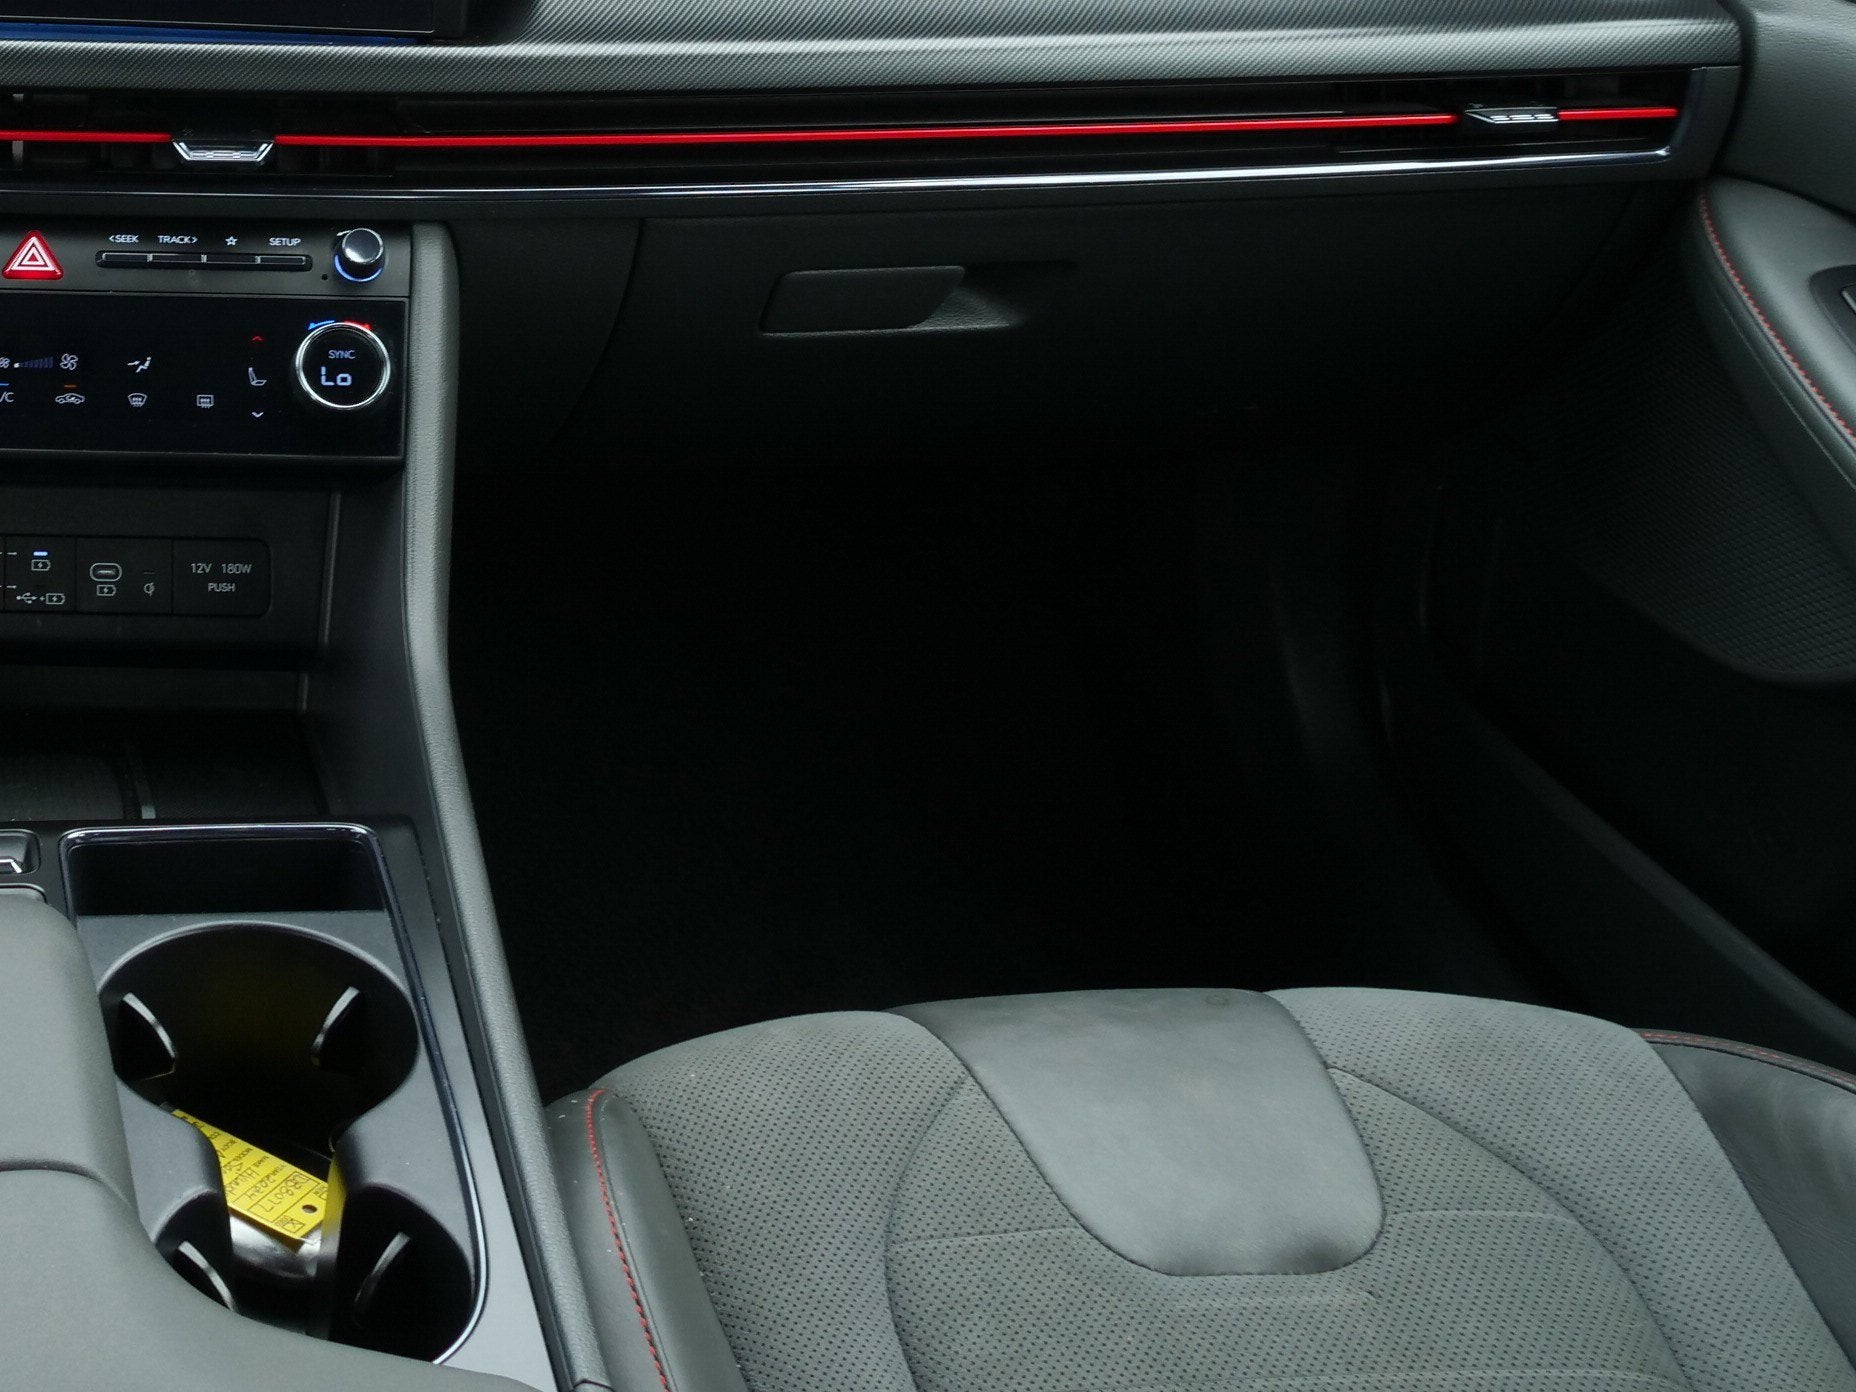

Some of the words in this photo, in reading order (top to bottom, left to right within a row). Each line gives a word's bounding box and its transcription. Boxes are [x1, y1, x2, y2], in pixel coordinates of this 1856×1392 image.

[269, 237, 301, 246] SETUP
[328, 349, 356, 359] SYNC
[320, 366, 352, 386] Lo
[190, 563, 212, 574] 12V
[221, 563, 252, 574] 180W
[207, 582, 236, 592] PUSH
